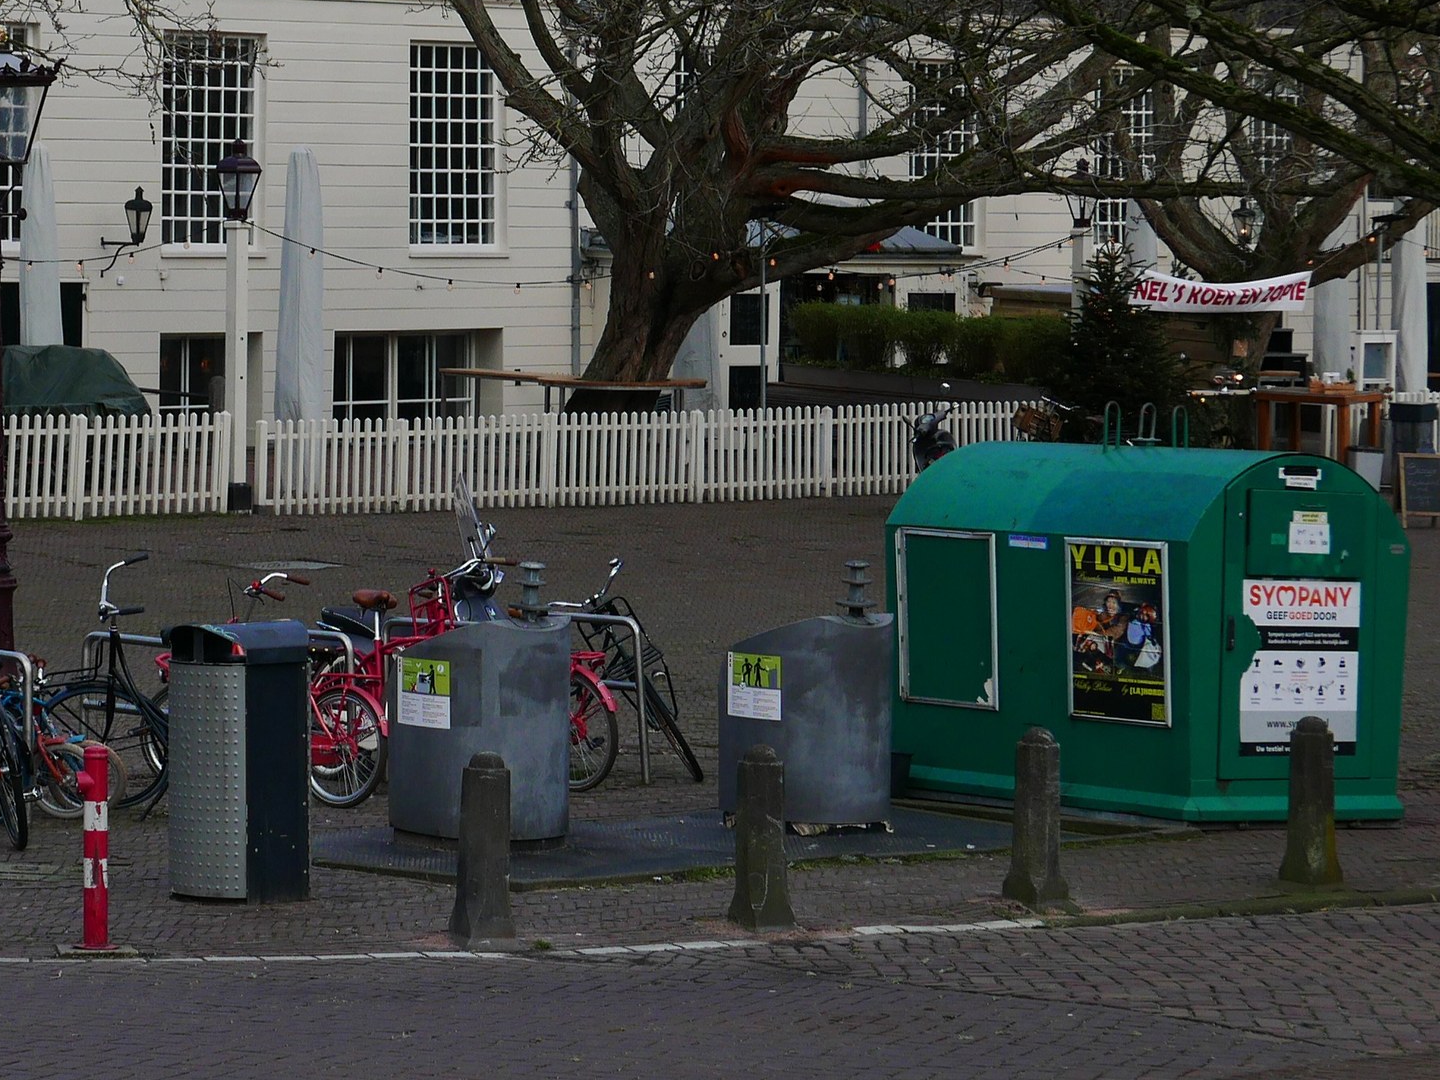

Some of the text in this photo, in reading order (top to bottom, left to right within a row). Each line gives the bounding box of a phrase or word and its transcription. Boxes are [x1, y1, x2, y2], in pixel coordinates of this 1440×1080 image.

[1237, 287, 1261, 305] EN
[1259, 281, 1307, 303] ZOPIE
[1071, 545, 1163, 574] Y LOLA
[1130, 577, 1156, 585] ALWAYS
[1250, 584, 1352, 607] SYMPANY
[1266, 611, 1337, 621] GEEF GOED DOOR
